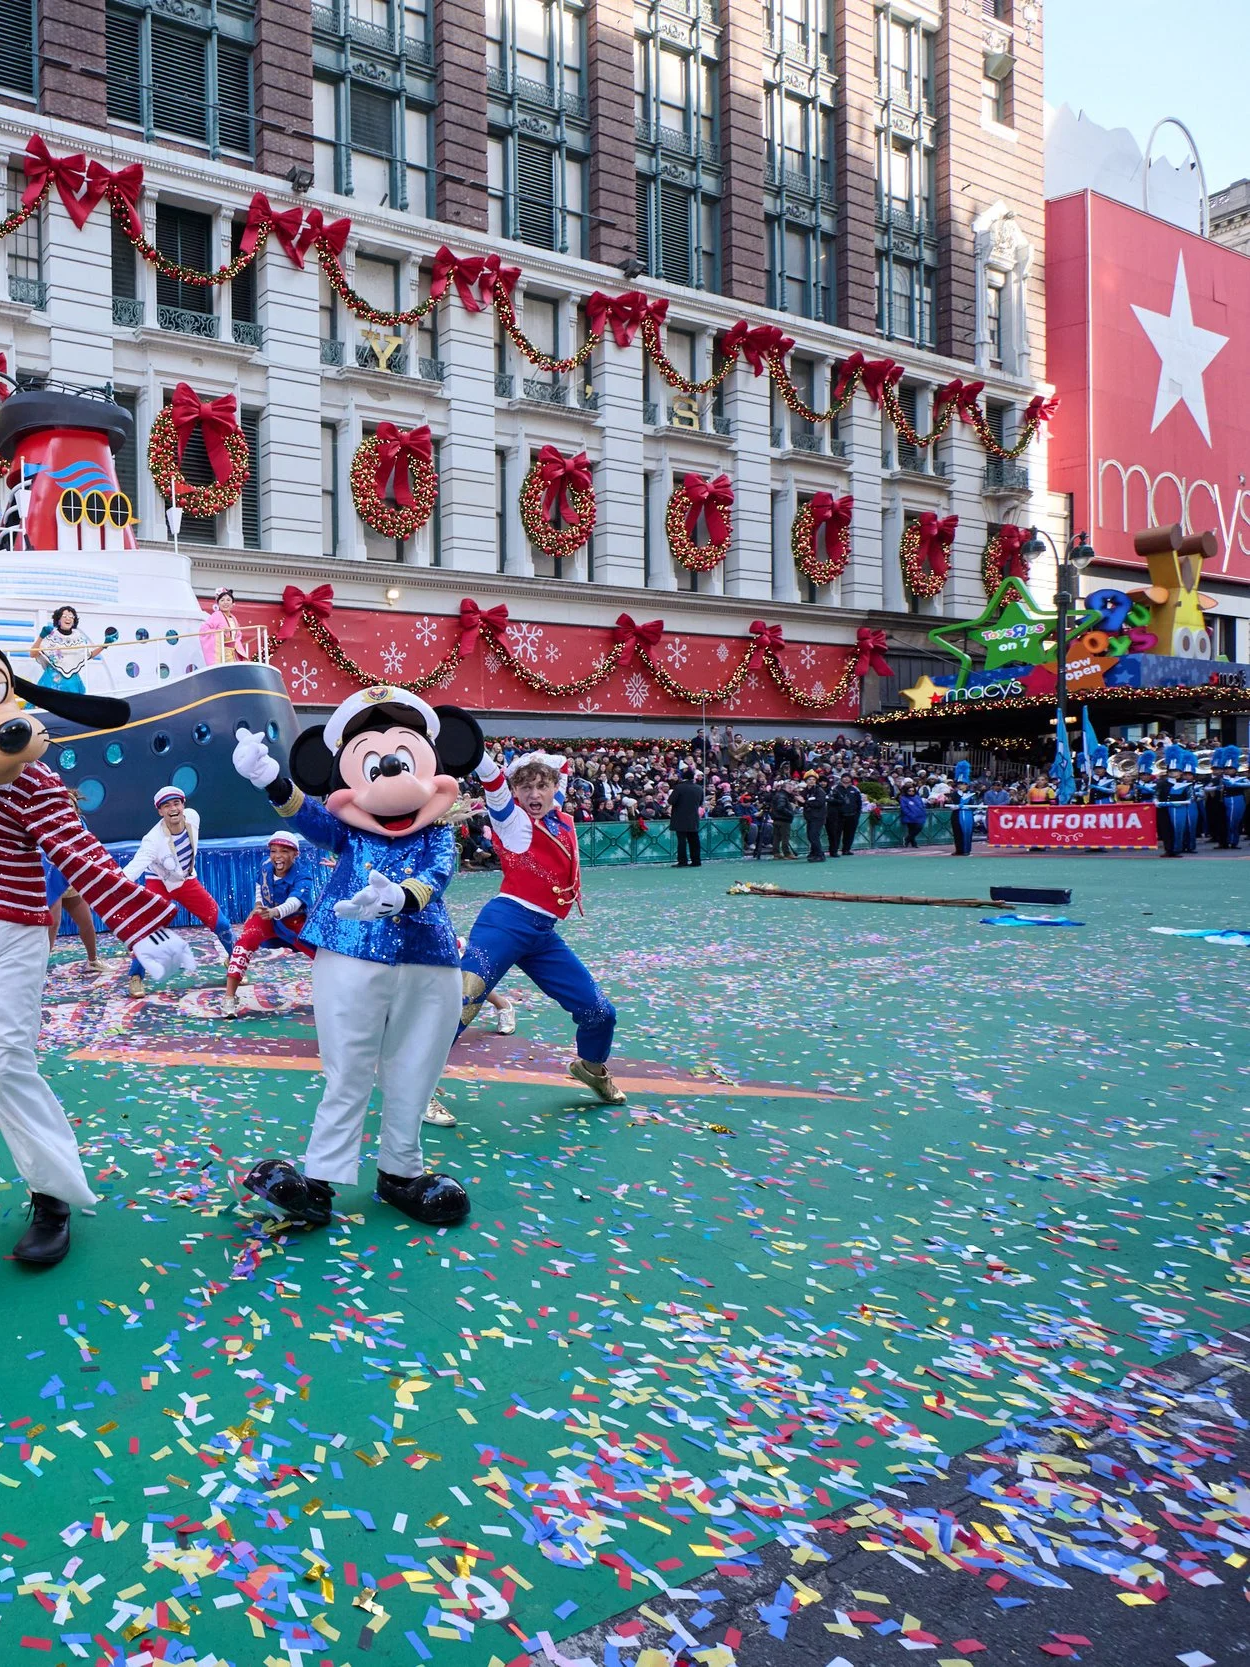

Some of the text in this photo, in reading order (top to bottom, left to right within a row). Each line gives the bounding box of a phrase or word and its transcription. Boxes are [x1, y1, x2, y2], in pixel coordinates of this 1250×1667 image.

[998, 637, 1030, 652] on 7
[945, 678, 1023, 703] macy's
[999, 812, 1143, 830] CALIFORNIA
